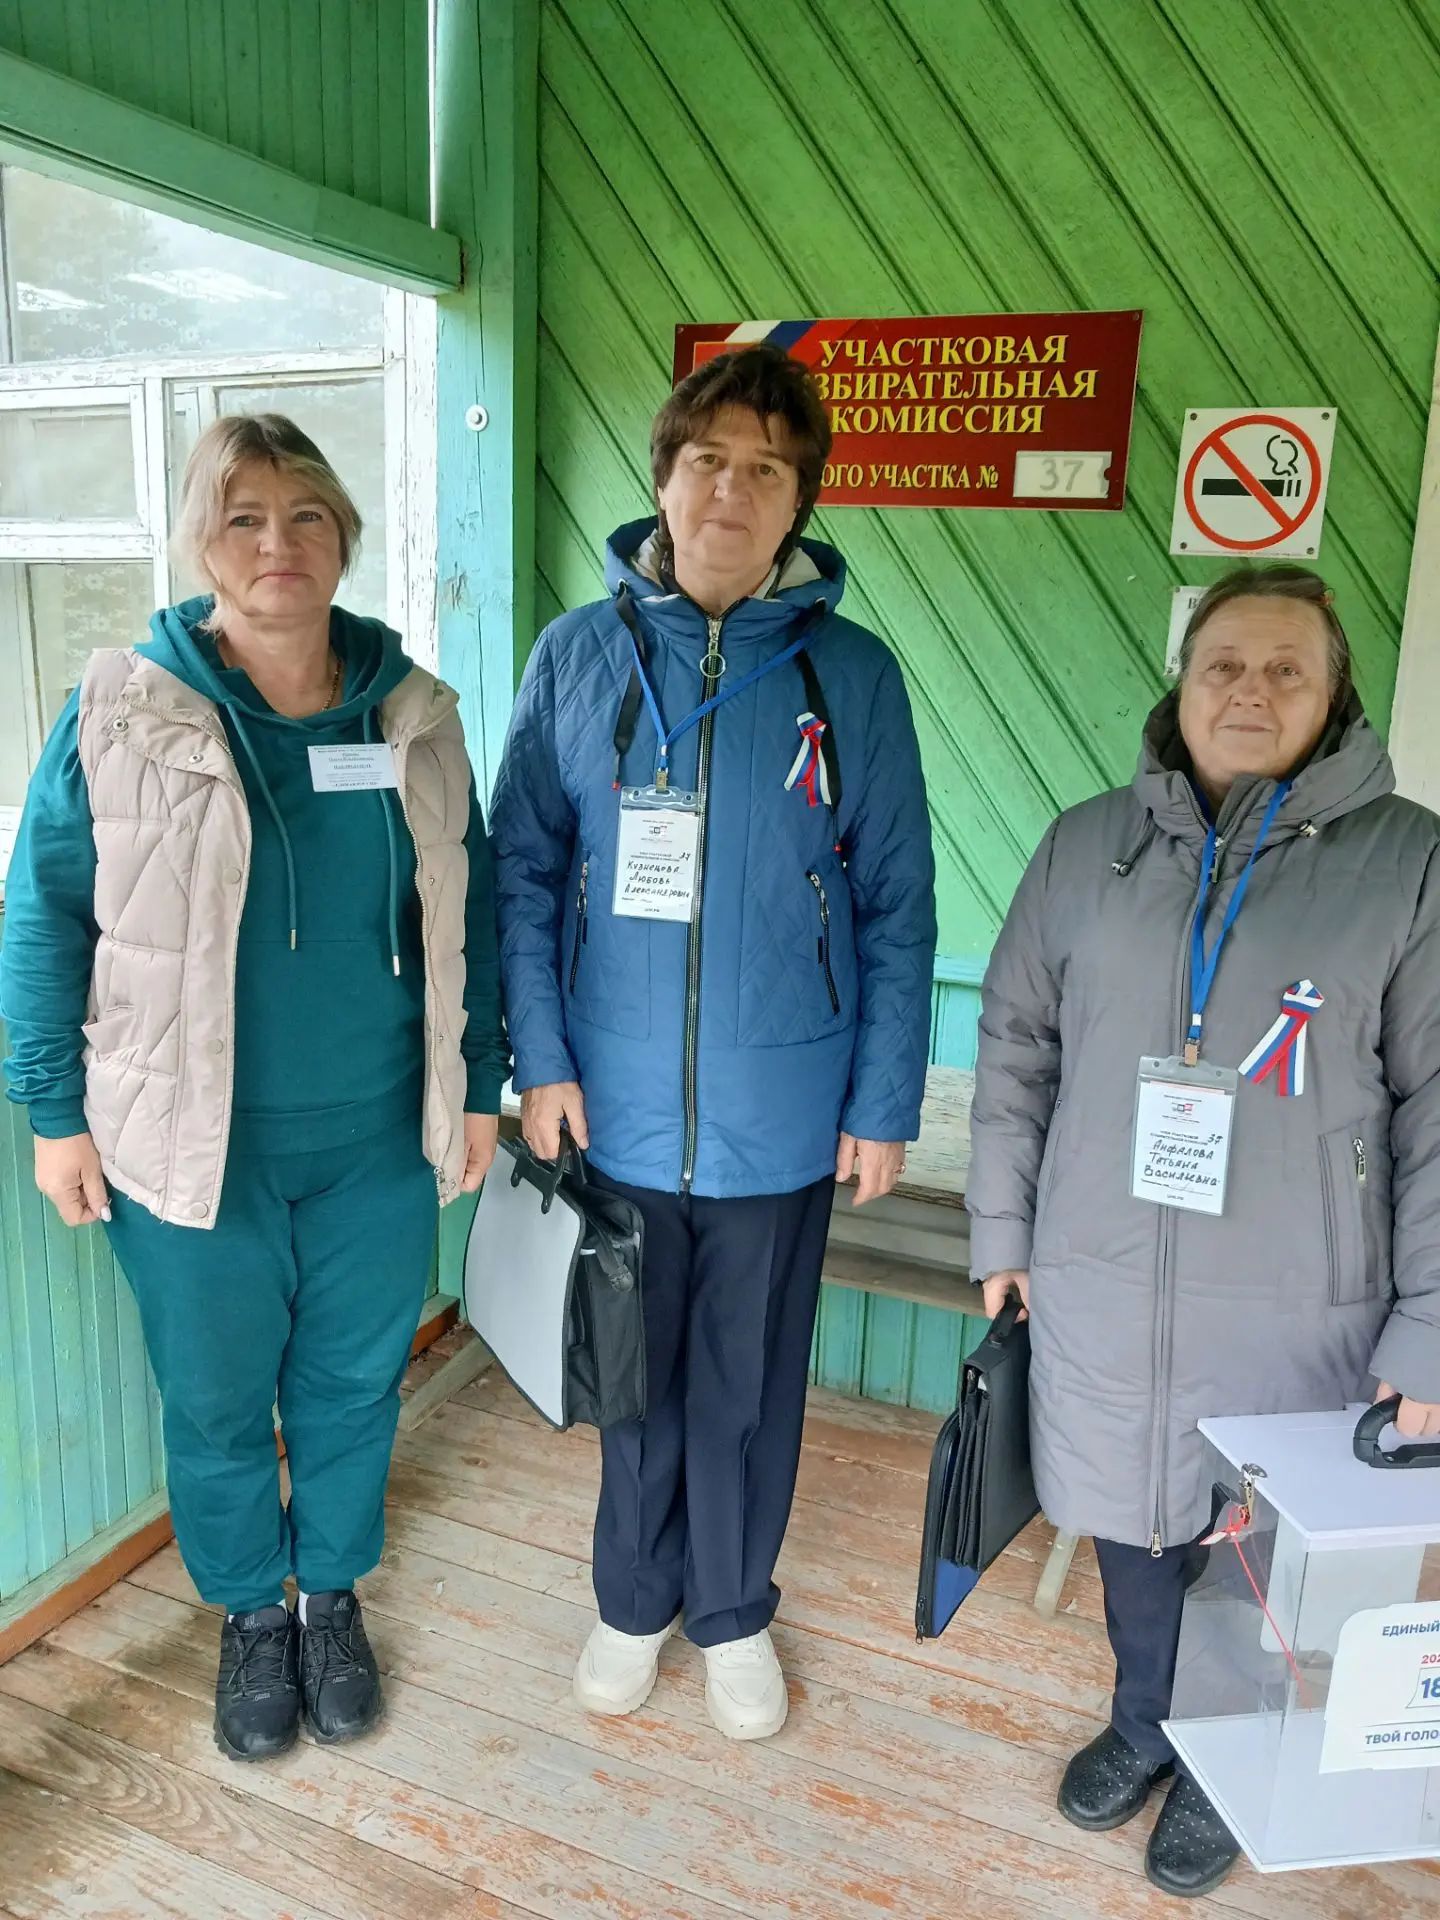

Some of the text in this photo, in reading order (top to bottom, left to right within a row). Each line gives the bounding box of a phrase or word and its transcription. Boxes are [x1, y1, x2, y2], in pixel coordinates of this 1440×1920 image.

[819, 334, 1069, 368] УЧАСТКОВАЯ
[814, 369, 1099, 400] ЗБИРАТЕЛЬНАЯ
[830, 404, 1046, 434] КОМИССИЯ
[821, 463, 864, 488] ОГО
[869, 462, 971, 489] УЧАСТКА
[1039, 456, 1085, 492] 37
[1382, 1620, 1440, 1637] ЕДИНЫЙ
[1365, 1728, 1440, 1745] ТВОЙ ГОЛО
